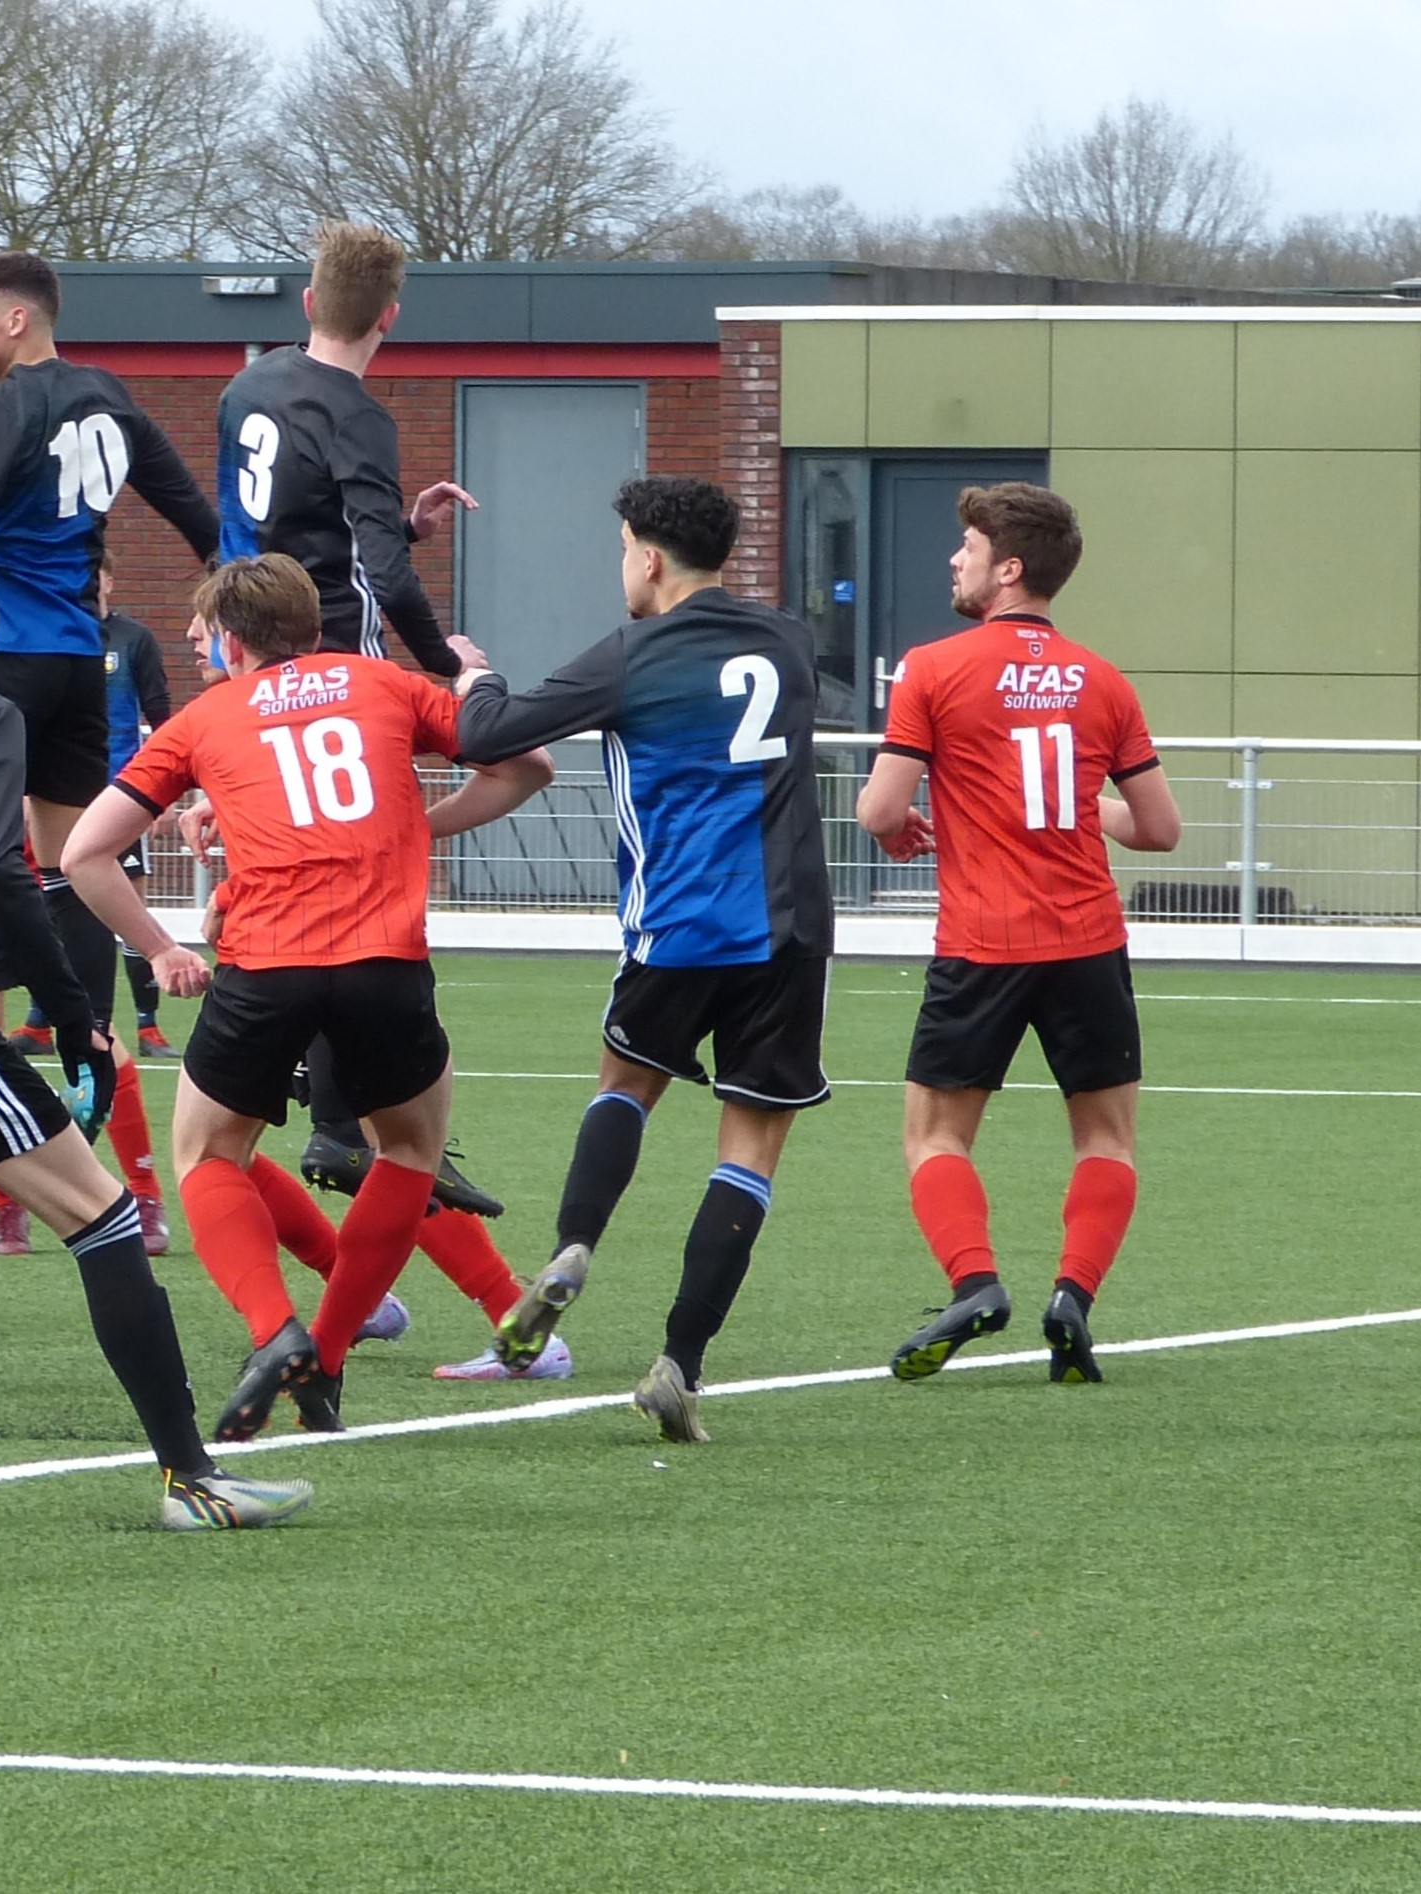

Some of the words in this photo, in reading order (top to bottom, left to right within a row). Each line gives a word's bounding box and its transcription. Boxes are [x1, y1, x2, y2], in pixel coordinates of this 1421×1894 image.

[48, 413, 129, 518] 10
[238, 413, 279, 521] 3
[247, 665, 350, 706] AFAS
[259, 687, 349, 717] software
[719, 654, 787, 764] 2
[996, 663, 1085, 693] AFAS
[1003, 692, 1077, 709] software
[258, 716, 375, 827] 18
[1010, 723, 1075, 830] 11
